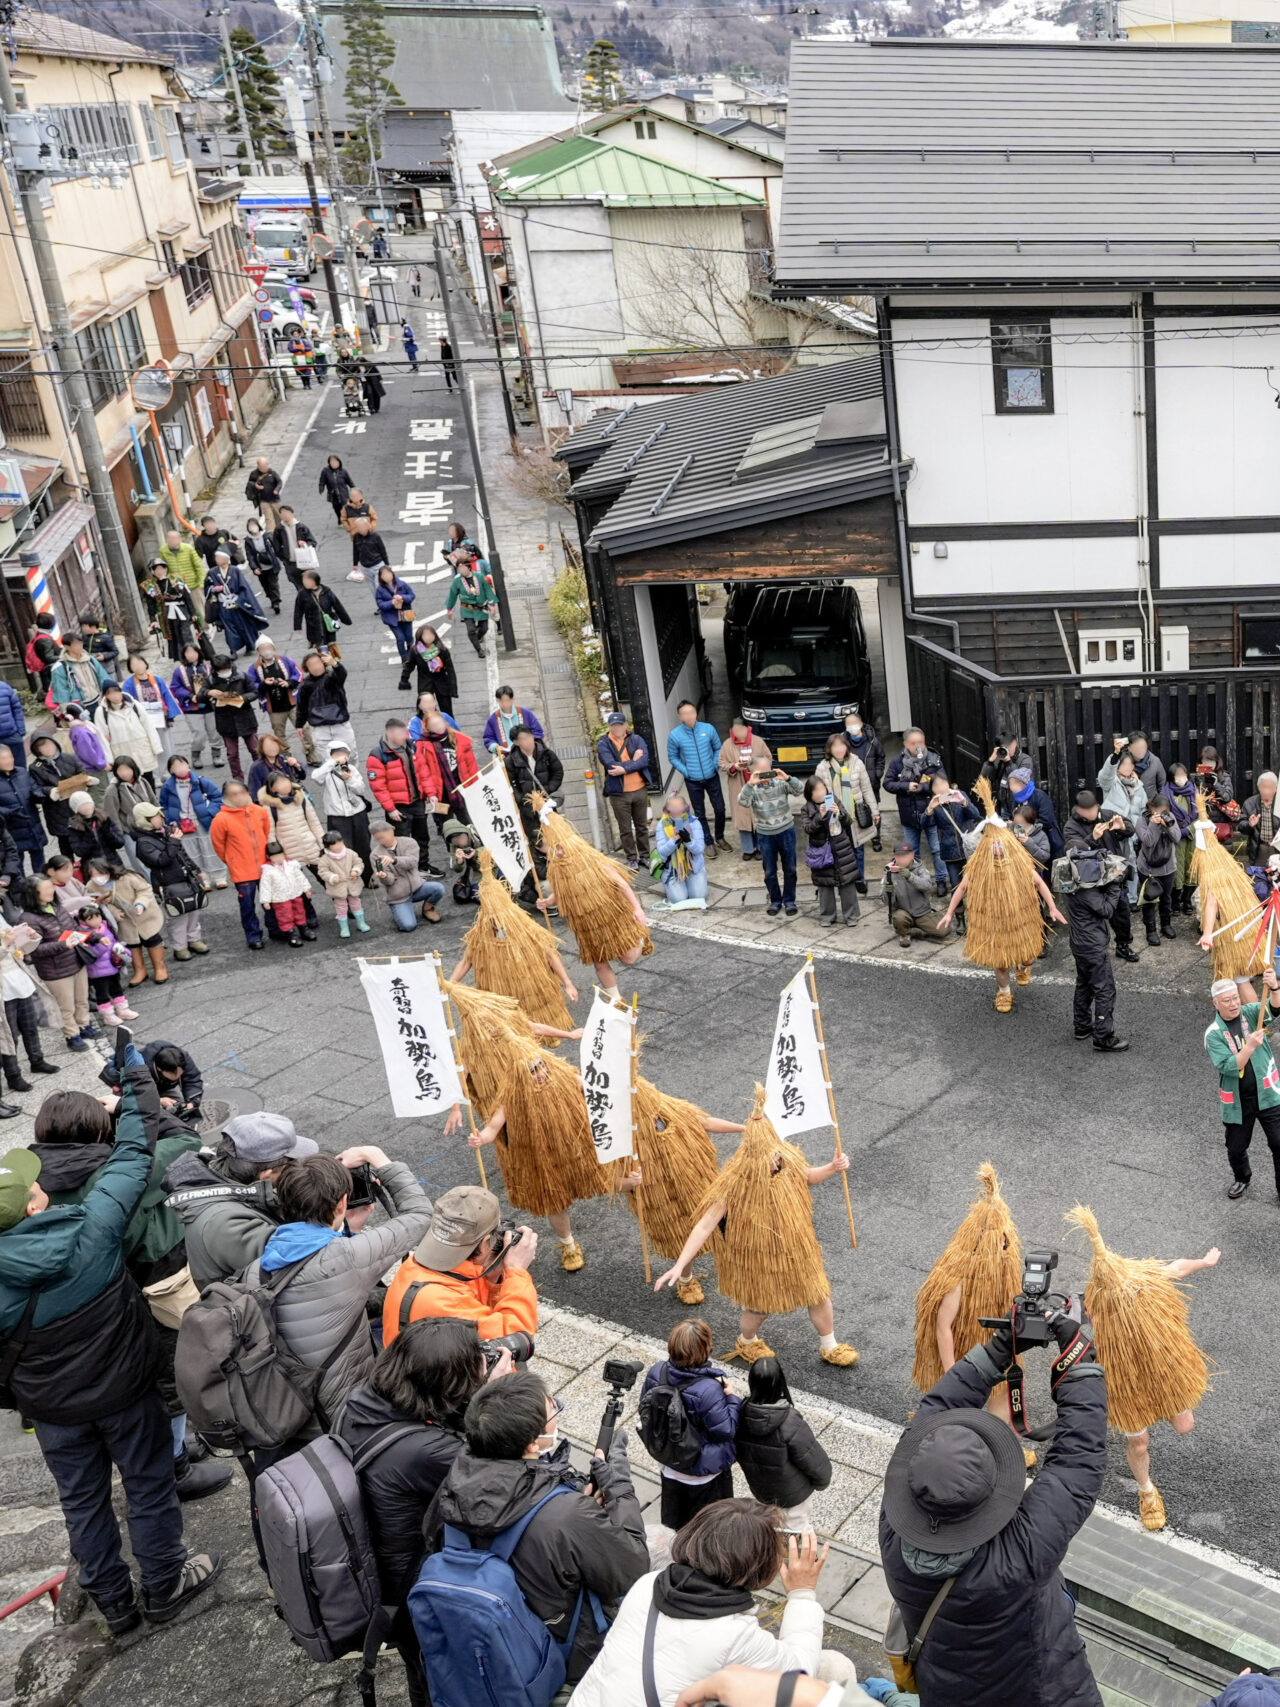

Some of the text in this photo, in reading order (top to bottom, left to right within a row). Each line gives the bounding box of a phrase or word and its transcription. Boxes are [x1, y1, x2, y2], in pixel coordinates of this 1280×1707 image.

[188, 1187, 232, 1200] FRONTIER
[1056, 1341, 1084, 1372] Canon
[1011, 1388, 1022, 1412] EOS
